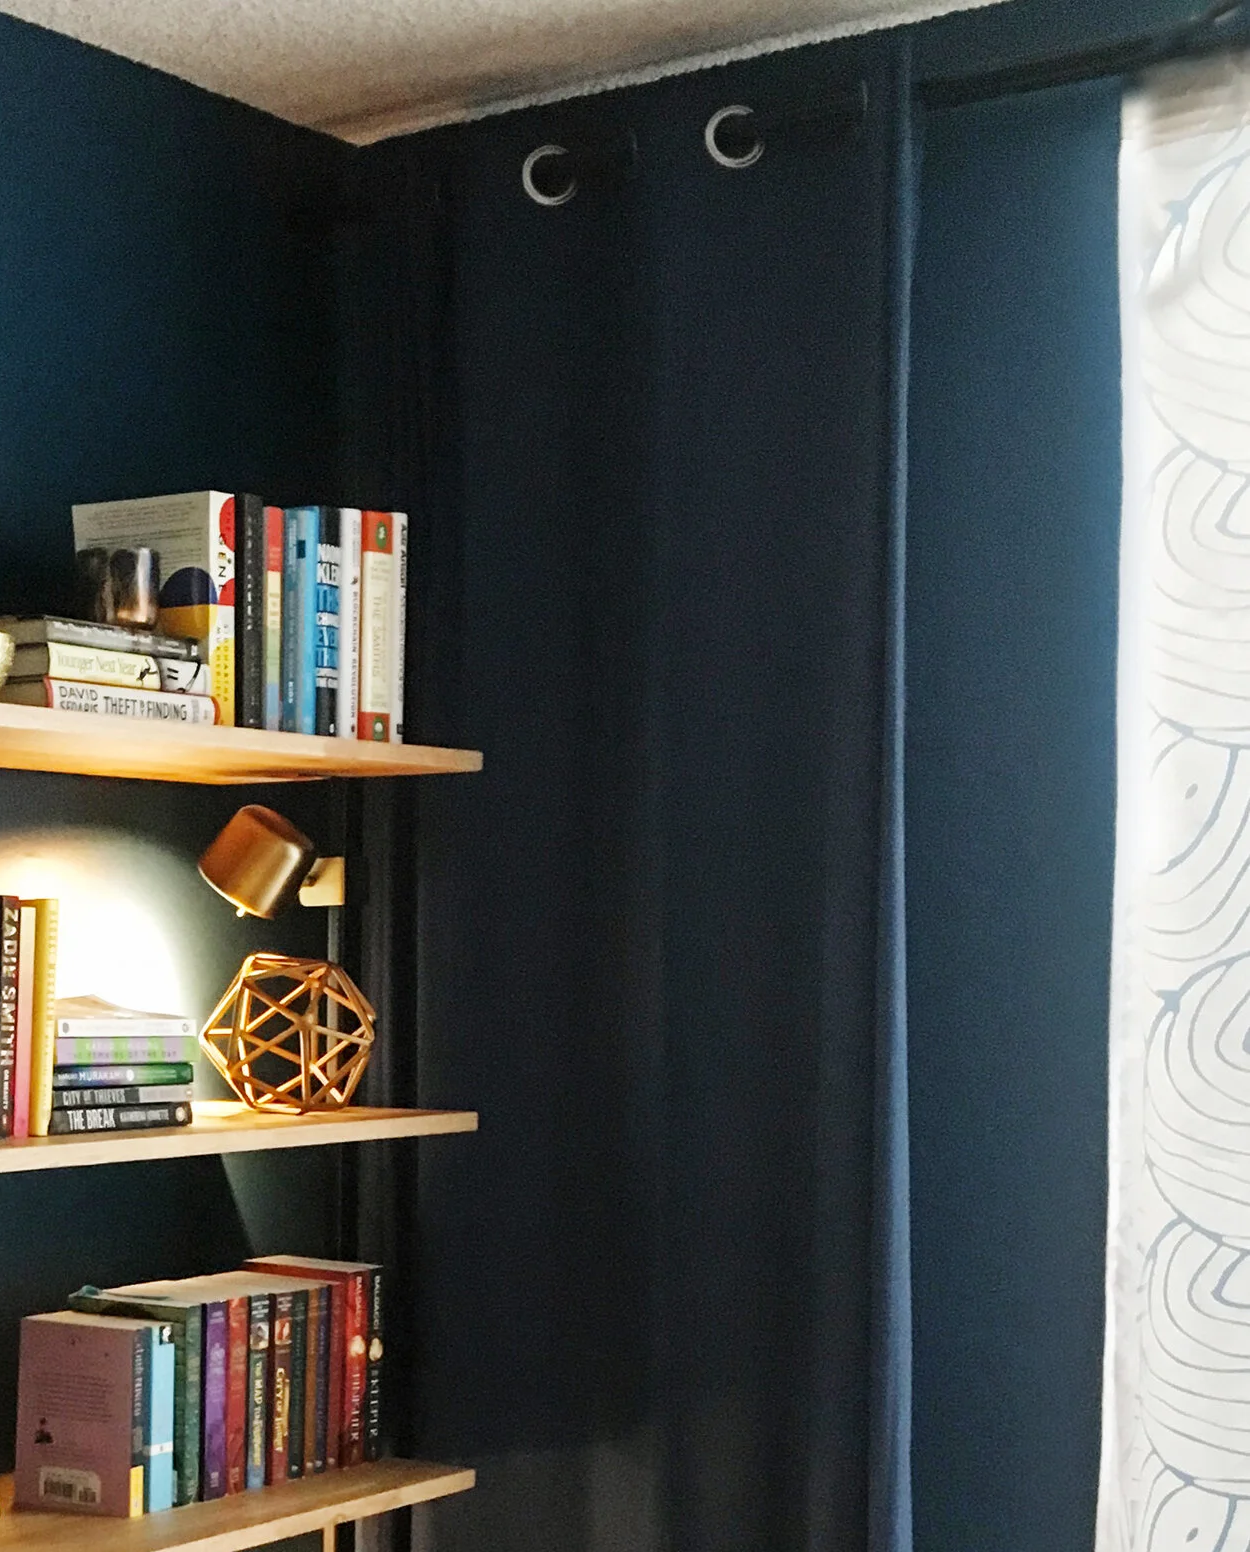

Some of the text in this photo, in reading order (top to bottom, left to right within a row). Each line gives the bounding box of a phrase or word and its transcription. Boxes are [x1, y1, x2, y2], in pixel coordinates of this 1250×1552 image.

[372, 595, 382, 621] THE
[56, 651, 137, 677] Younger Next Year
[371, 625, 382, 678] SMITHS
[58, 686, 99, 701] DAVID
[103, 696, 138, 716] THEFT
[147, 700, 188, 721] FINDING
[0, 906, 19, 1066] ZADIE SMITH
[62, 1090, 81, 1105] CITY
[94, 1088, 126, 1104] THIEVES
[66, 1108, 116, 1131] THE BREAK
[372, 1275, 381, 1330] BALDACCI
[253, 1379, 263, 1405] MAP
